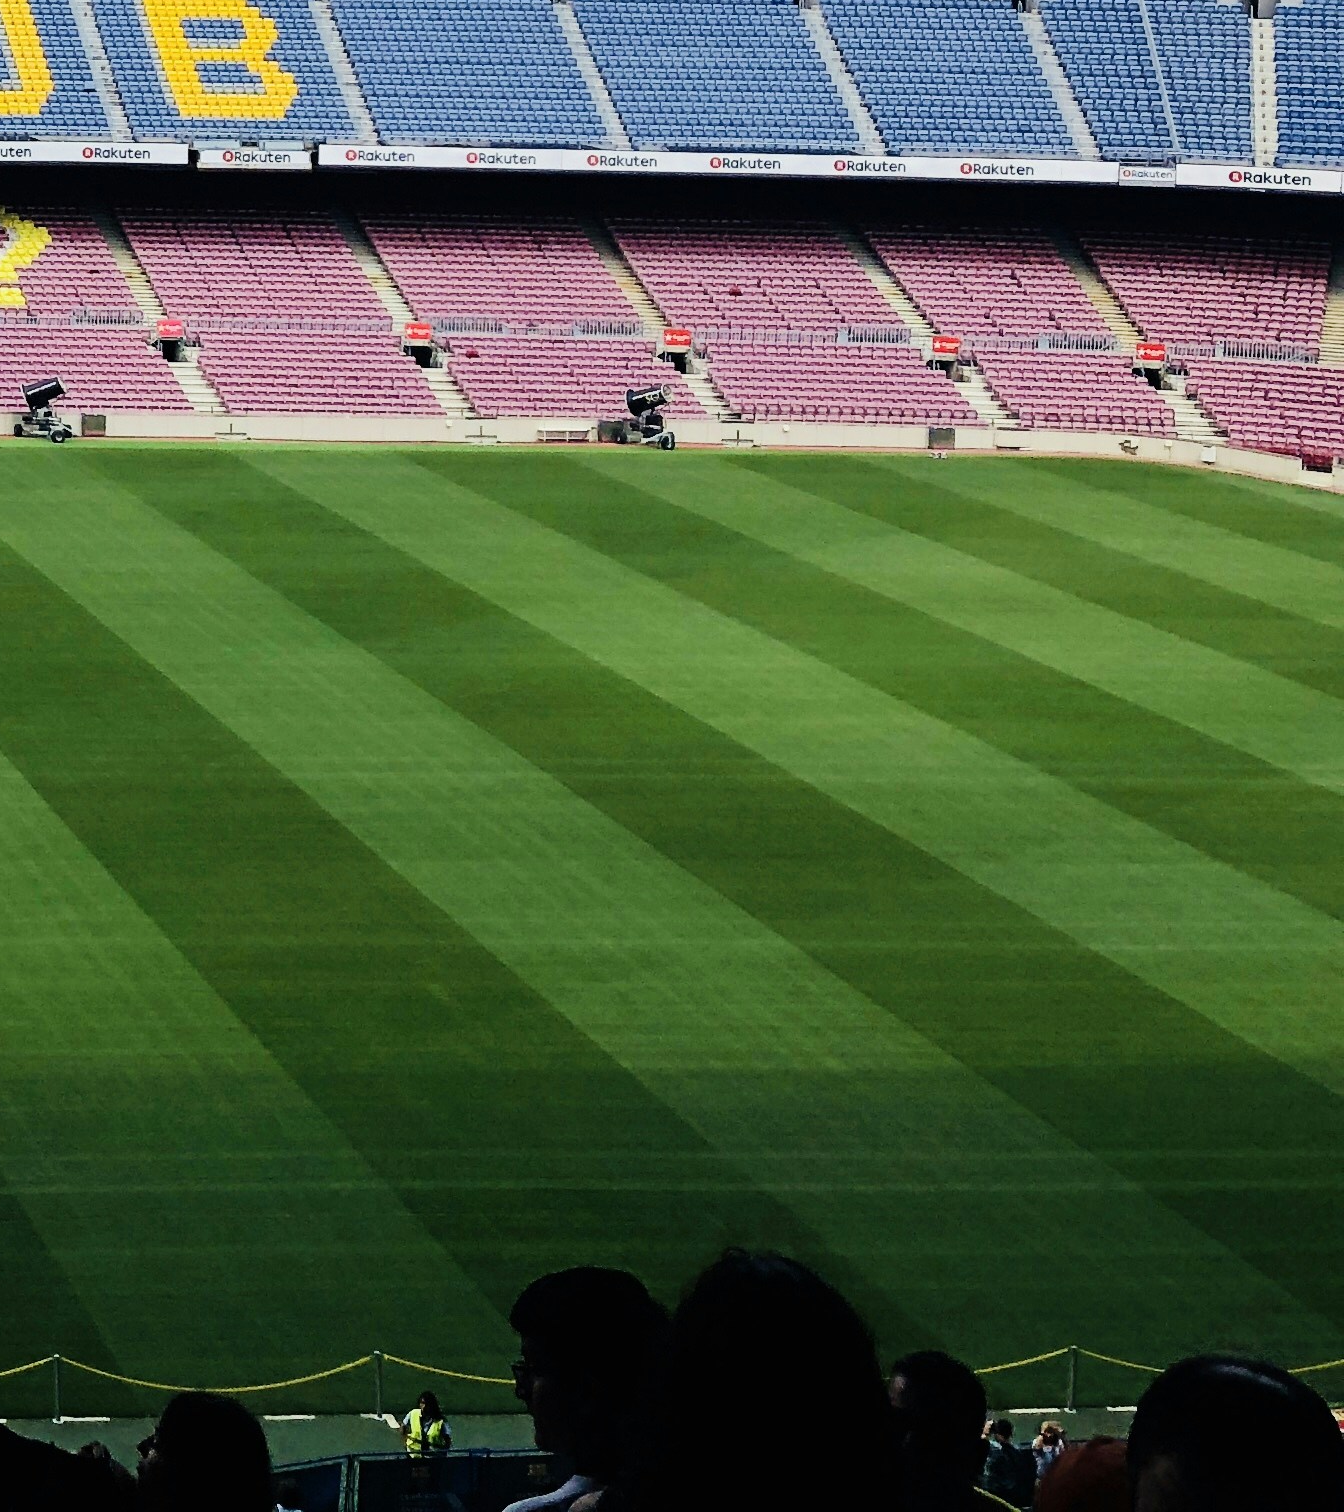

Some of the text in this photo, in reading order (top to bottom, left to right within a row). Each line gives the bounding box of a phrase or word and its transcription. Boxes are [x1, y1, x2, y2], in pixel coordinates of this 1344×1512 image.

[94, 147, 151, 159] Rakuten
[234, 151, 291, 163] Rakuten
[358, 150, 415, 163] Rakuten
[478, 152, 537, 166] Rakuten
[599, 155, 657, 168] Rakuten
[722, 157, 781, 171] Rakuten
[846, 160, 907, 173] Rakuten
[973, 163, 1035, 177] Rakuten
[1242, 171, 1312, 186] Rakuten
